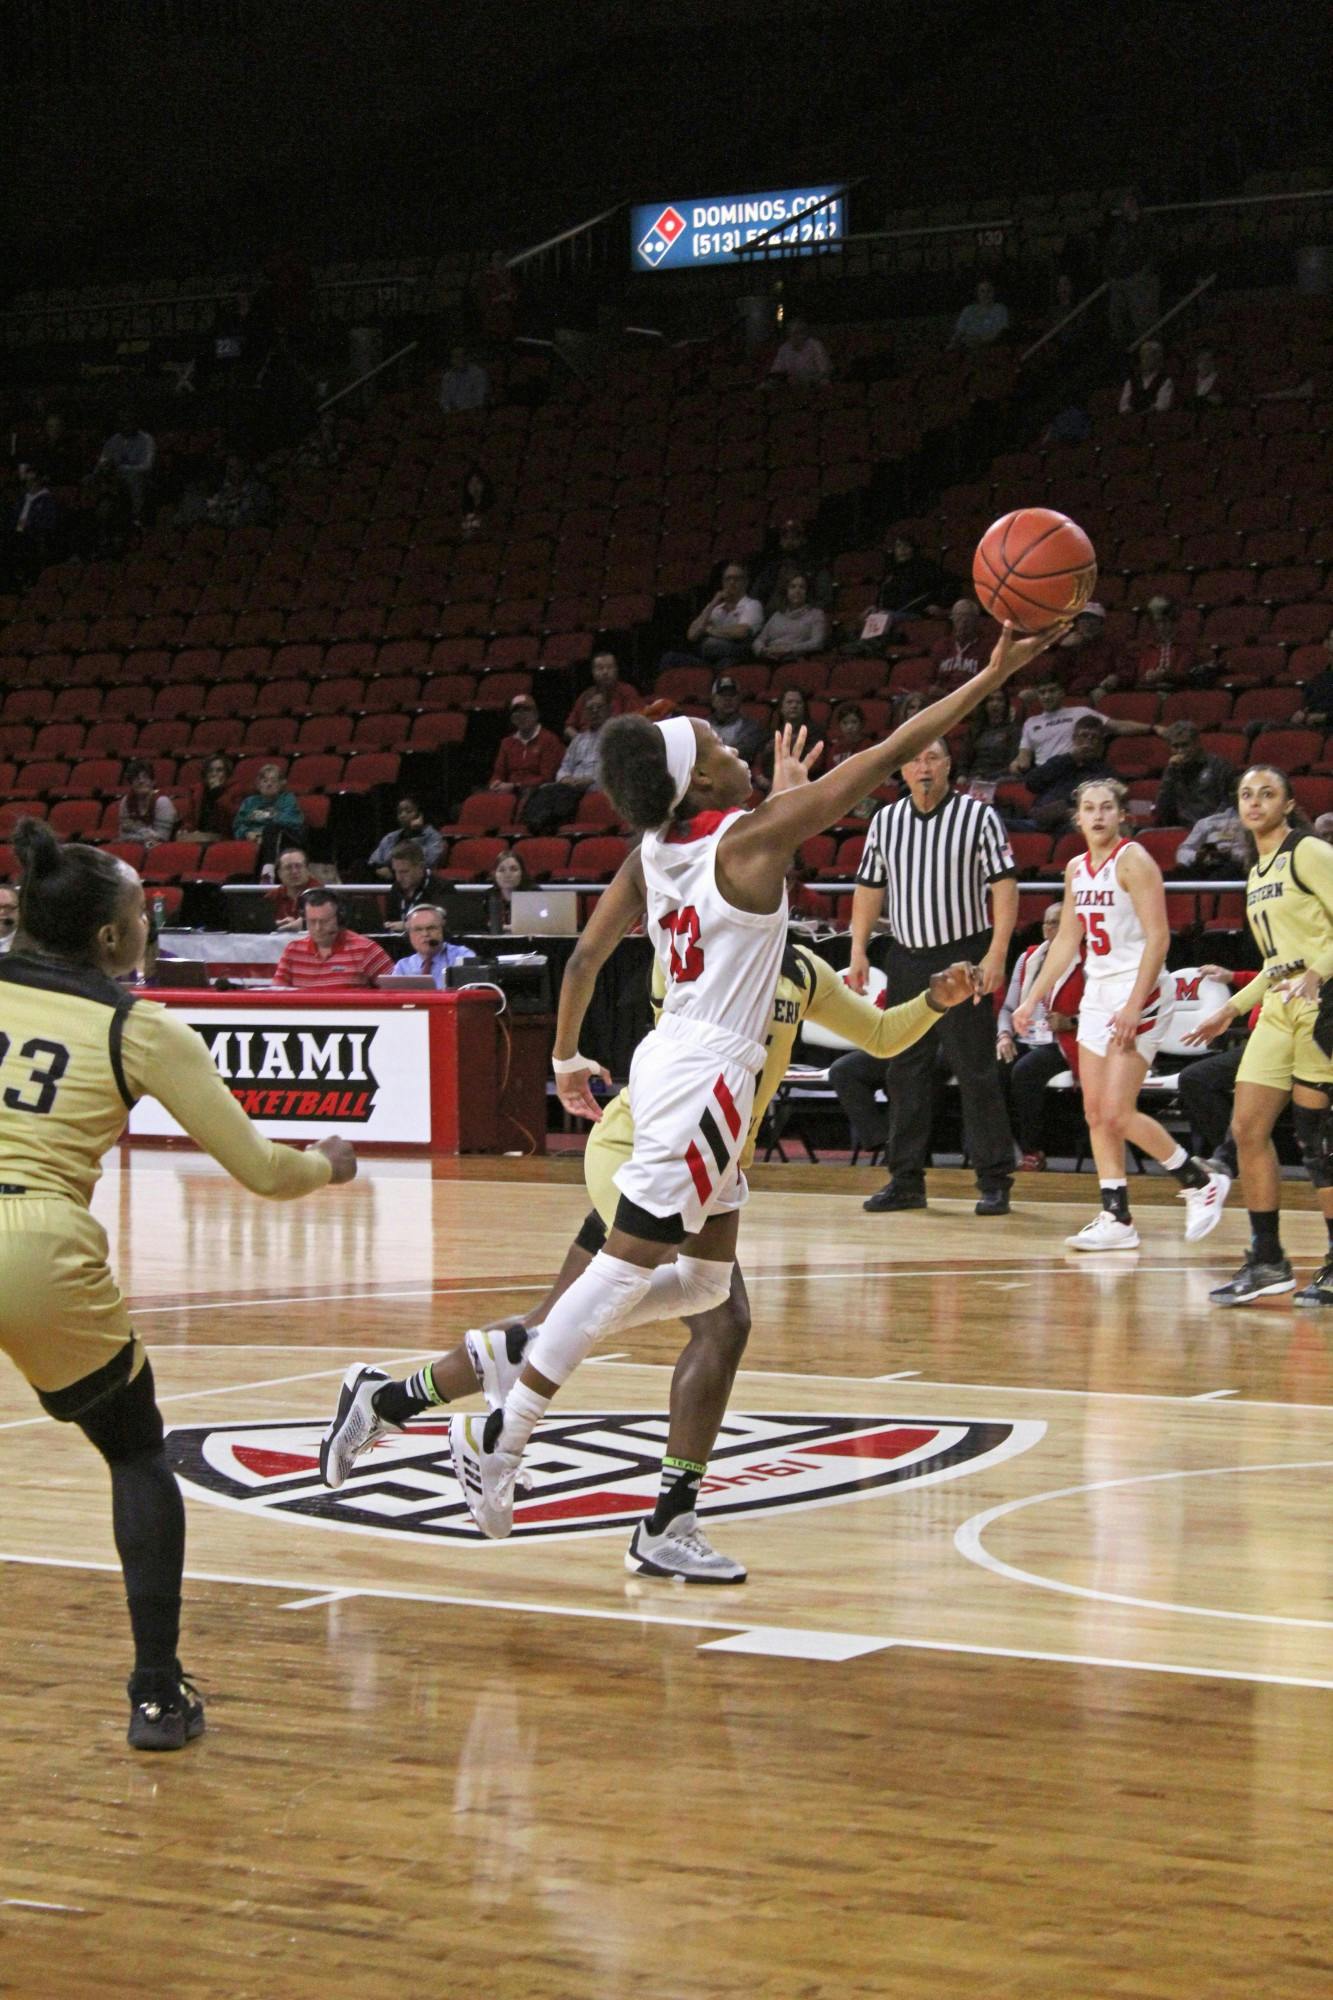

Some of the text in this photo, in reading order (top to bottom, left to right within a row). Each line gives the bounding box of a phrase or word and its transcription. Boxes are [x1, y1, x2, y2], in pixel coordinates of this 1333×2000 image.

[692, 194, 838, 228] DOMINOS.COM
[692, 229, 740, 257] (513)
[1075, 890, 1116, 907] IAMI
